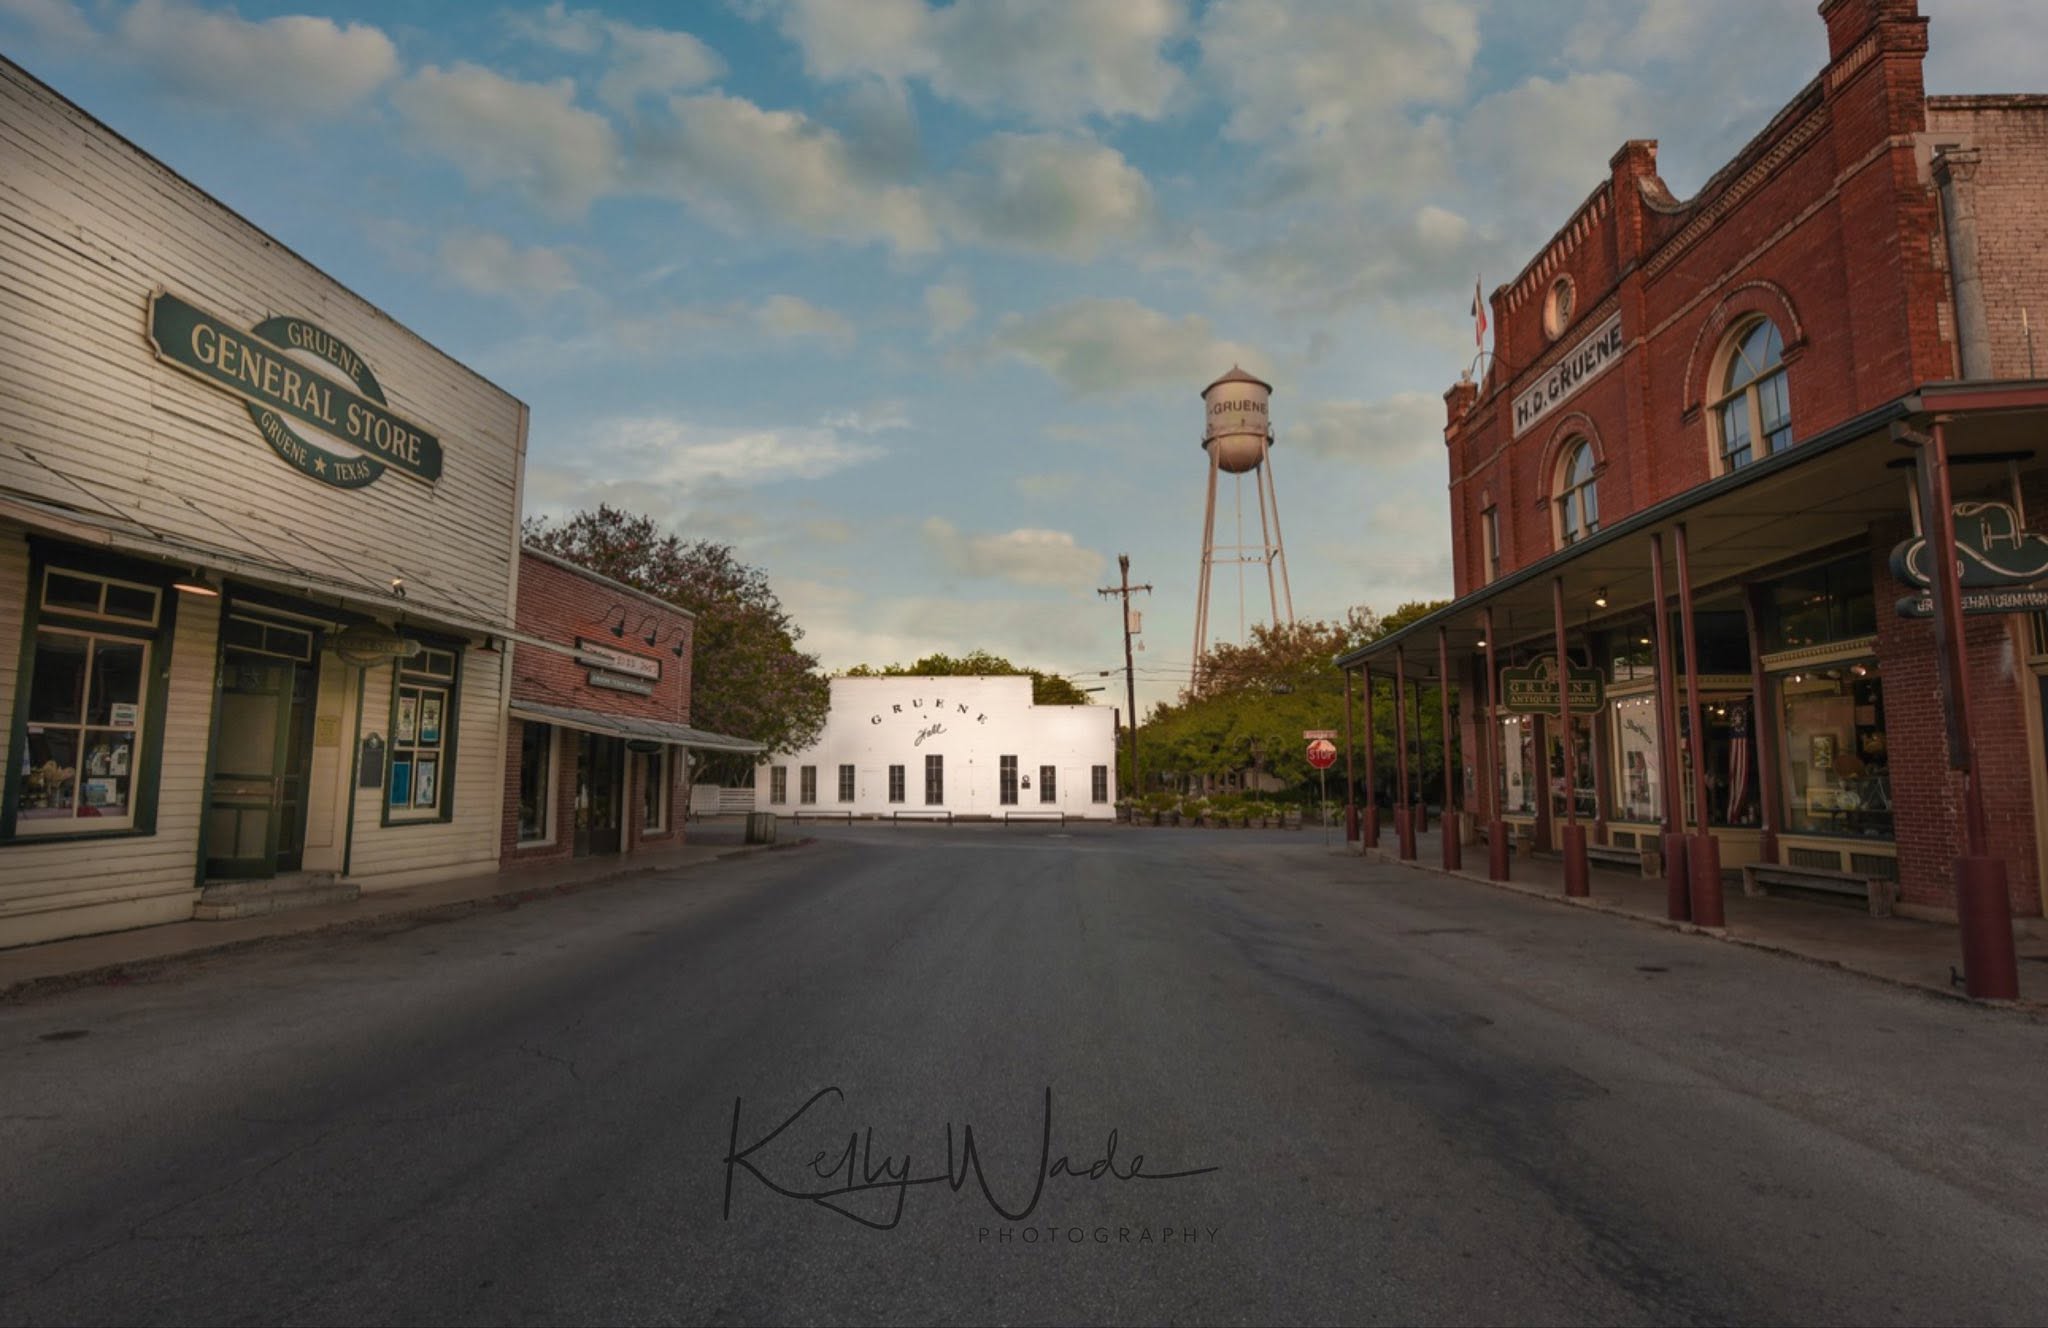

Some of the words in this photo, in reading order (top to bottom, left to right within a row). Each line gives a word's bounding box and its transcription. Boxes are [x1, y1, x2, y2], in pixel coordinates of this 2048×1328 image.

[287, 322, 363, 382] GRUENE
[1548, 324, 1622, 399] GRUENE
[191, 323, 337, 425] GENERAL
[345, 402, 422, 466] STORE
[1213, 399, 1267, 415] GRUENE
[261, 410, 306, 468] GRUENE
[333, 459, 371, 481] TEXAS
[1510, 682, 1596, 693] GRUNE
[1511, 695, 1551, 705] ANTIQUE
[870, 698, 988, 725] GRUENE
